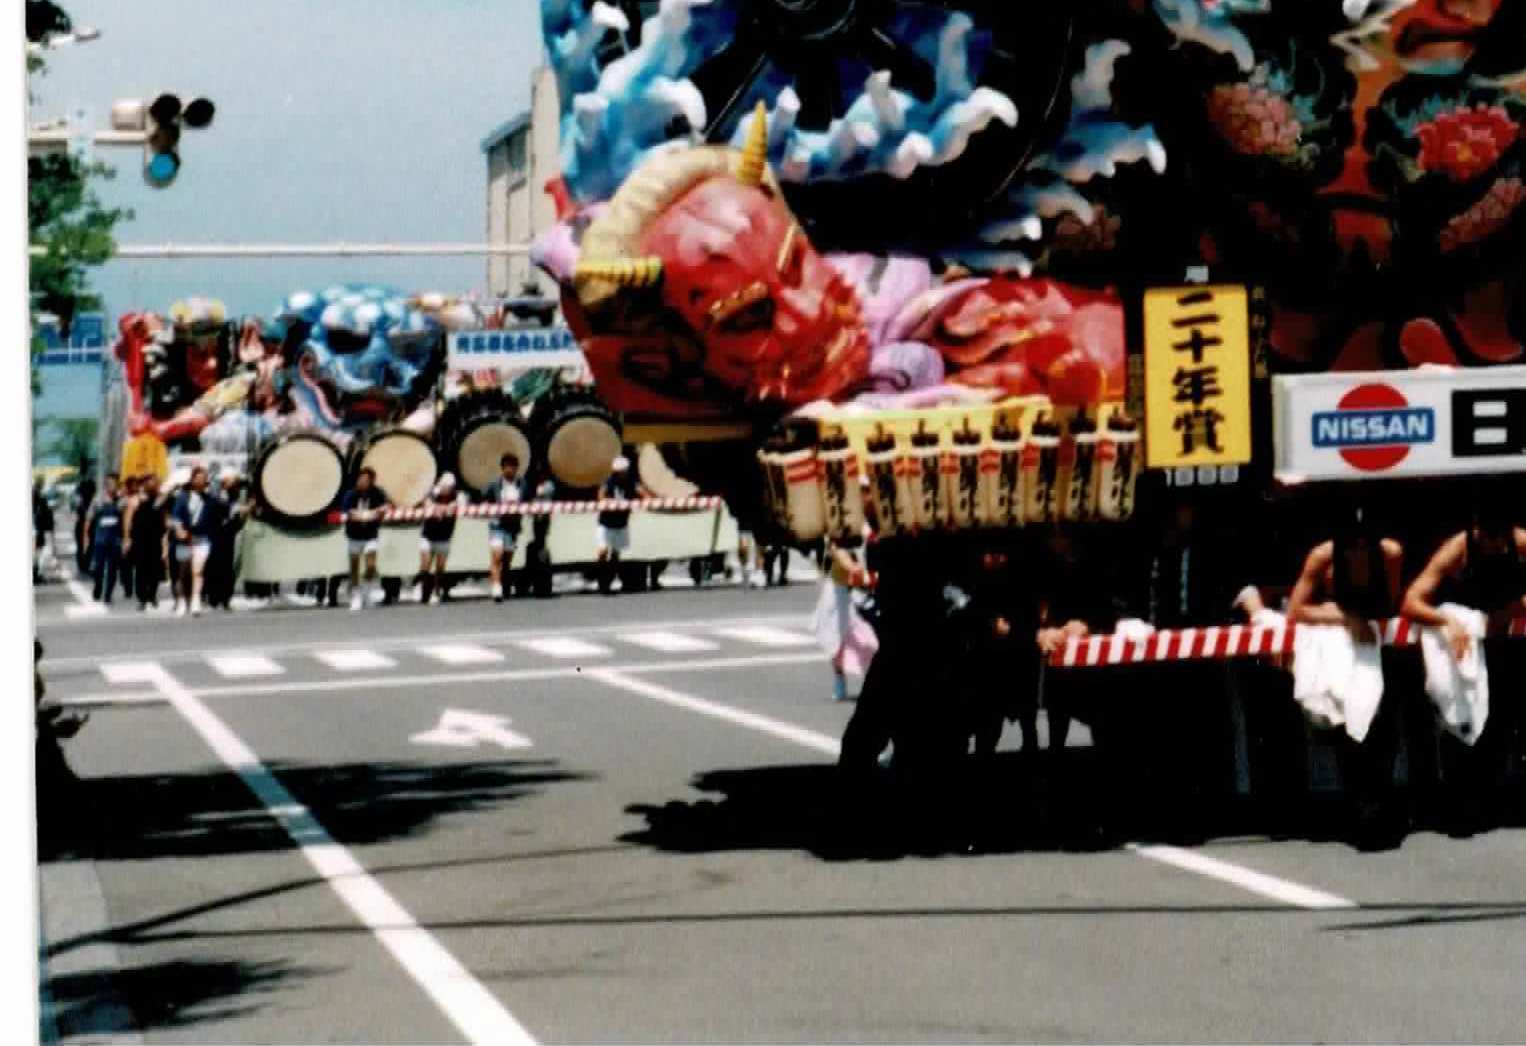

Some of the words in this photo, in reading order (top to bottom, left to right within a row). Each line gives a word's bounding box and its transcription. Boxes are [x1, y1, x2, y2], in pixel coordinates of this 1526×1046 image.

[1171, 291, 1225, 457] 二十年賞
[1318, 413, 1430, 442] NISSAN
